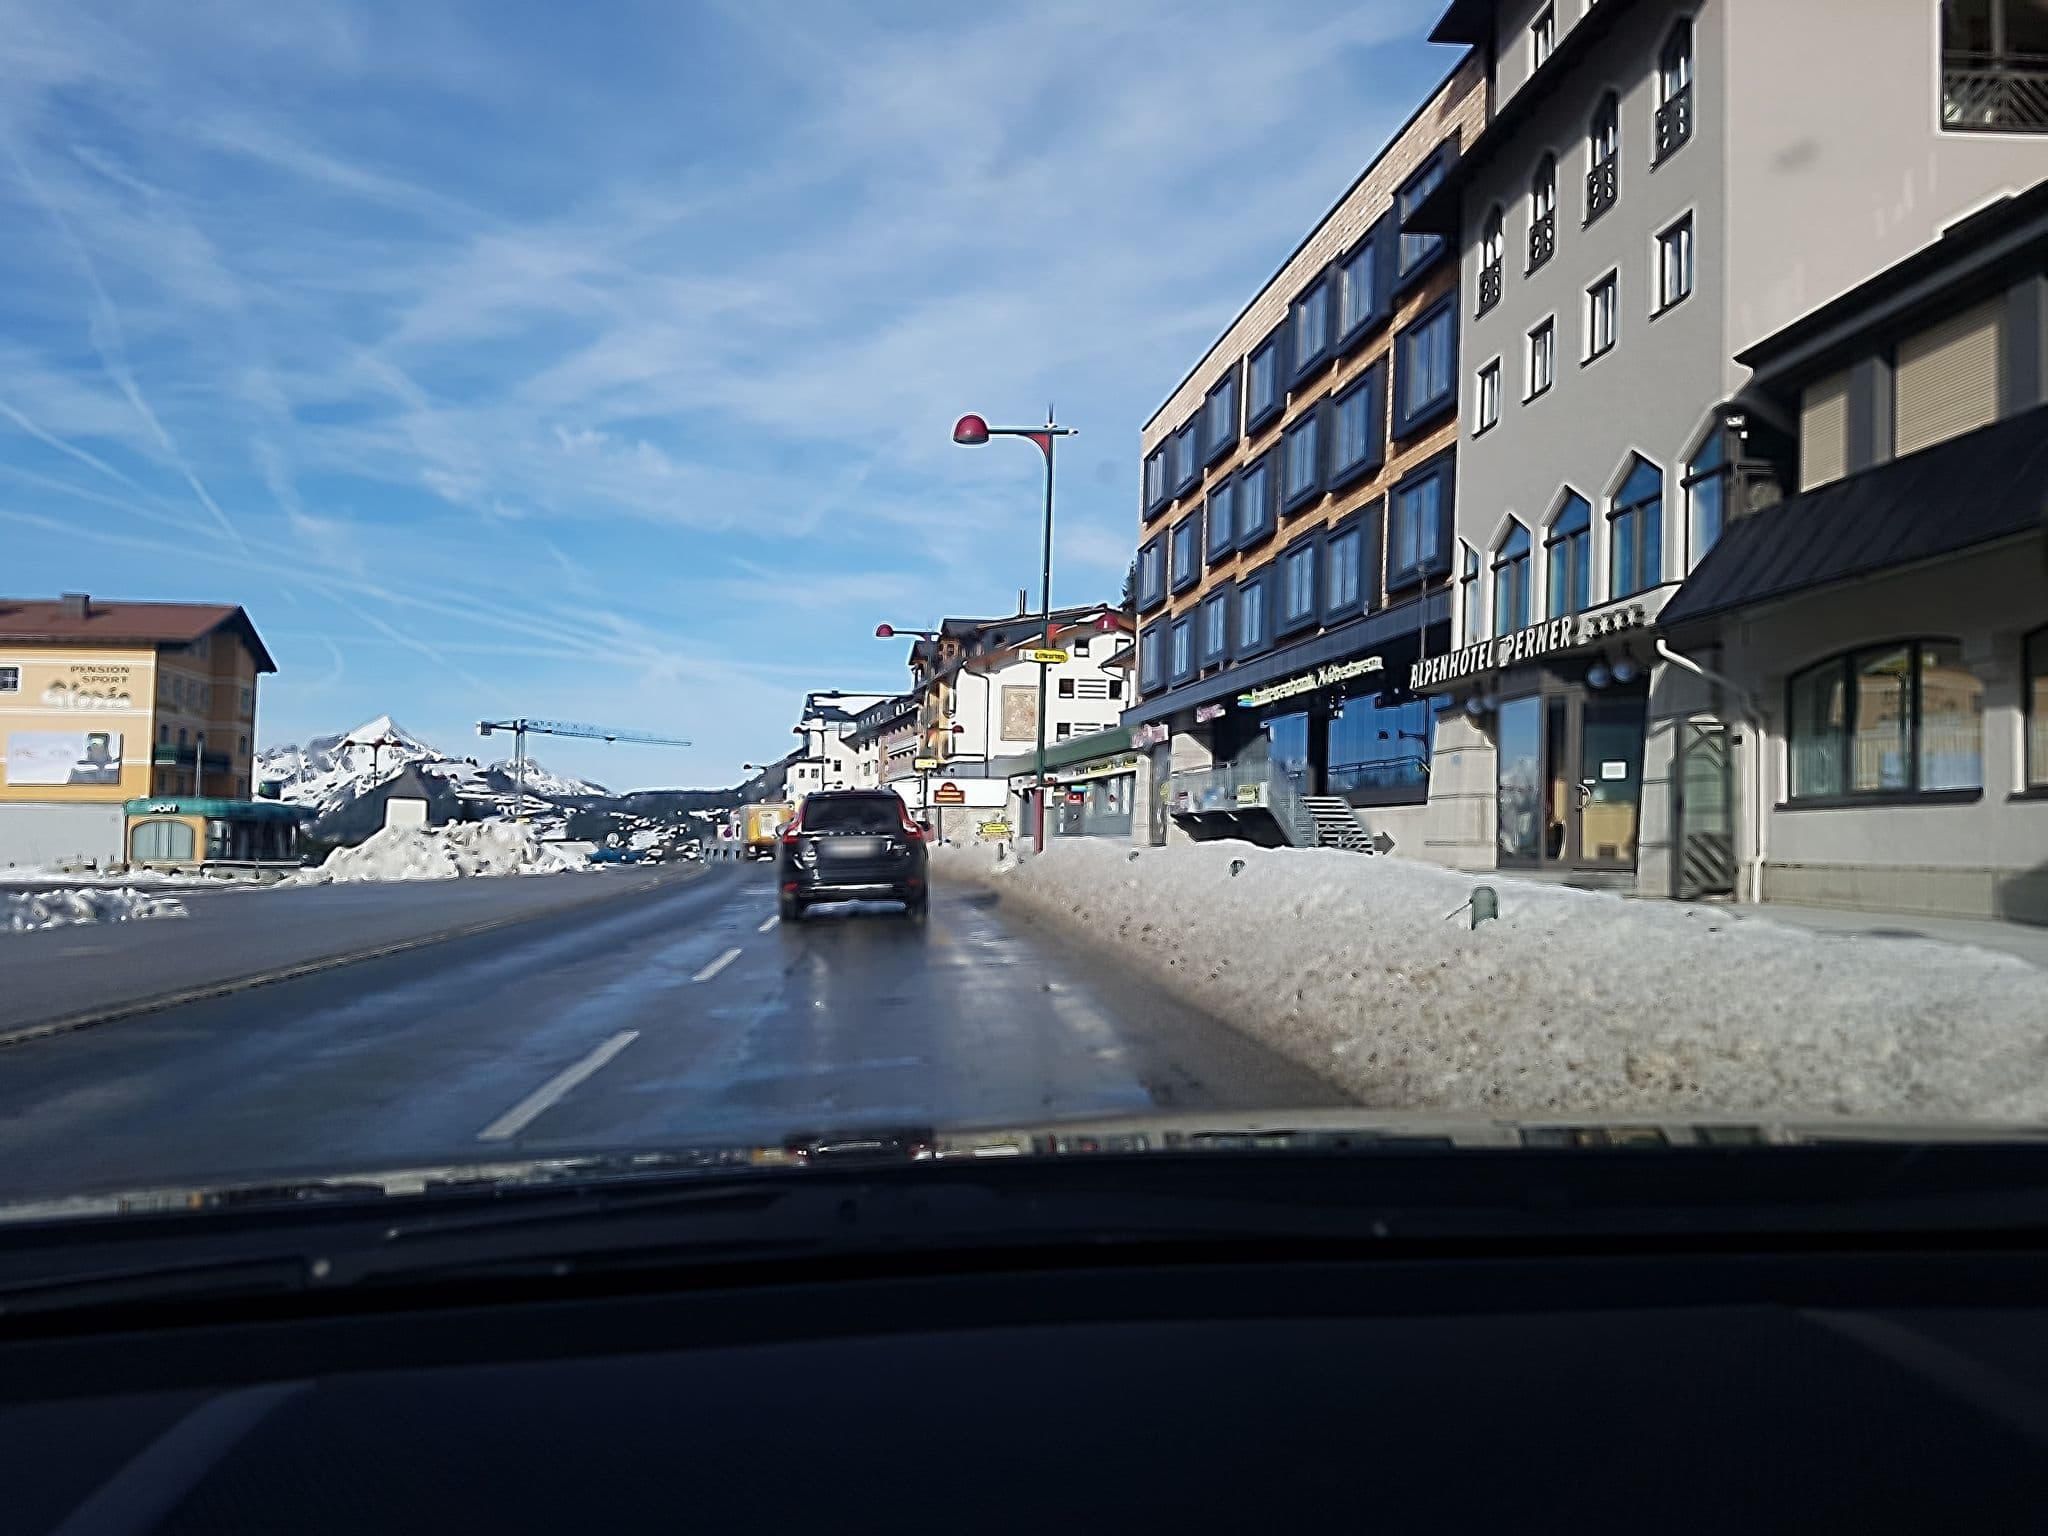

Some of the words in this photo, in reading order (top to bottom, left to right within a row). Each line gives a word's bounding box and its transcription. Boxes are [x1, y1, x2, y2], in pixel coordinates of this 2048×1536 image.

[1409, 640, 1494, 690] ALPENHOTEL
[1506, 615, 1573, 661] PERNER
[70, 666, 130, 674] PENSION
[81, 675, 129, 684] SPORT
